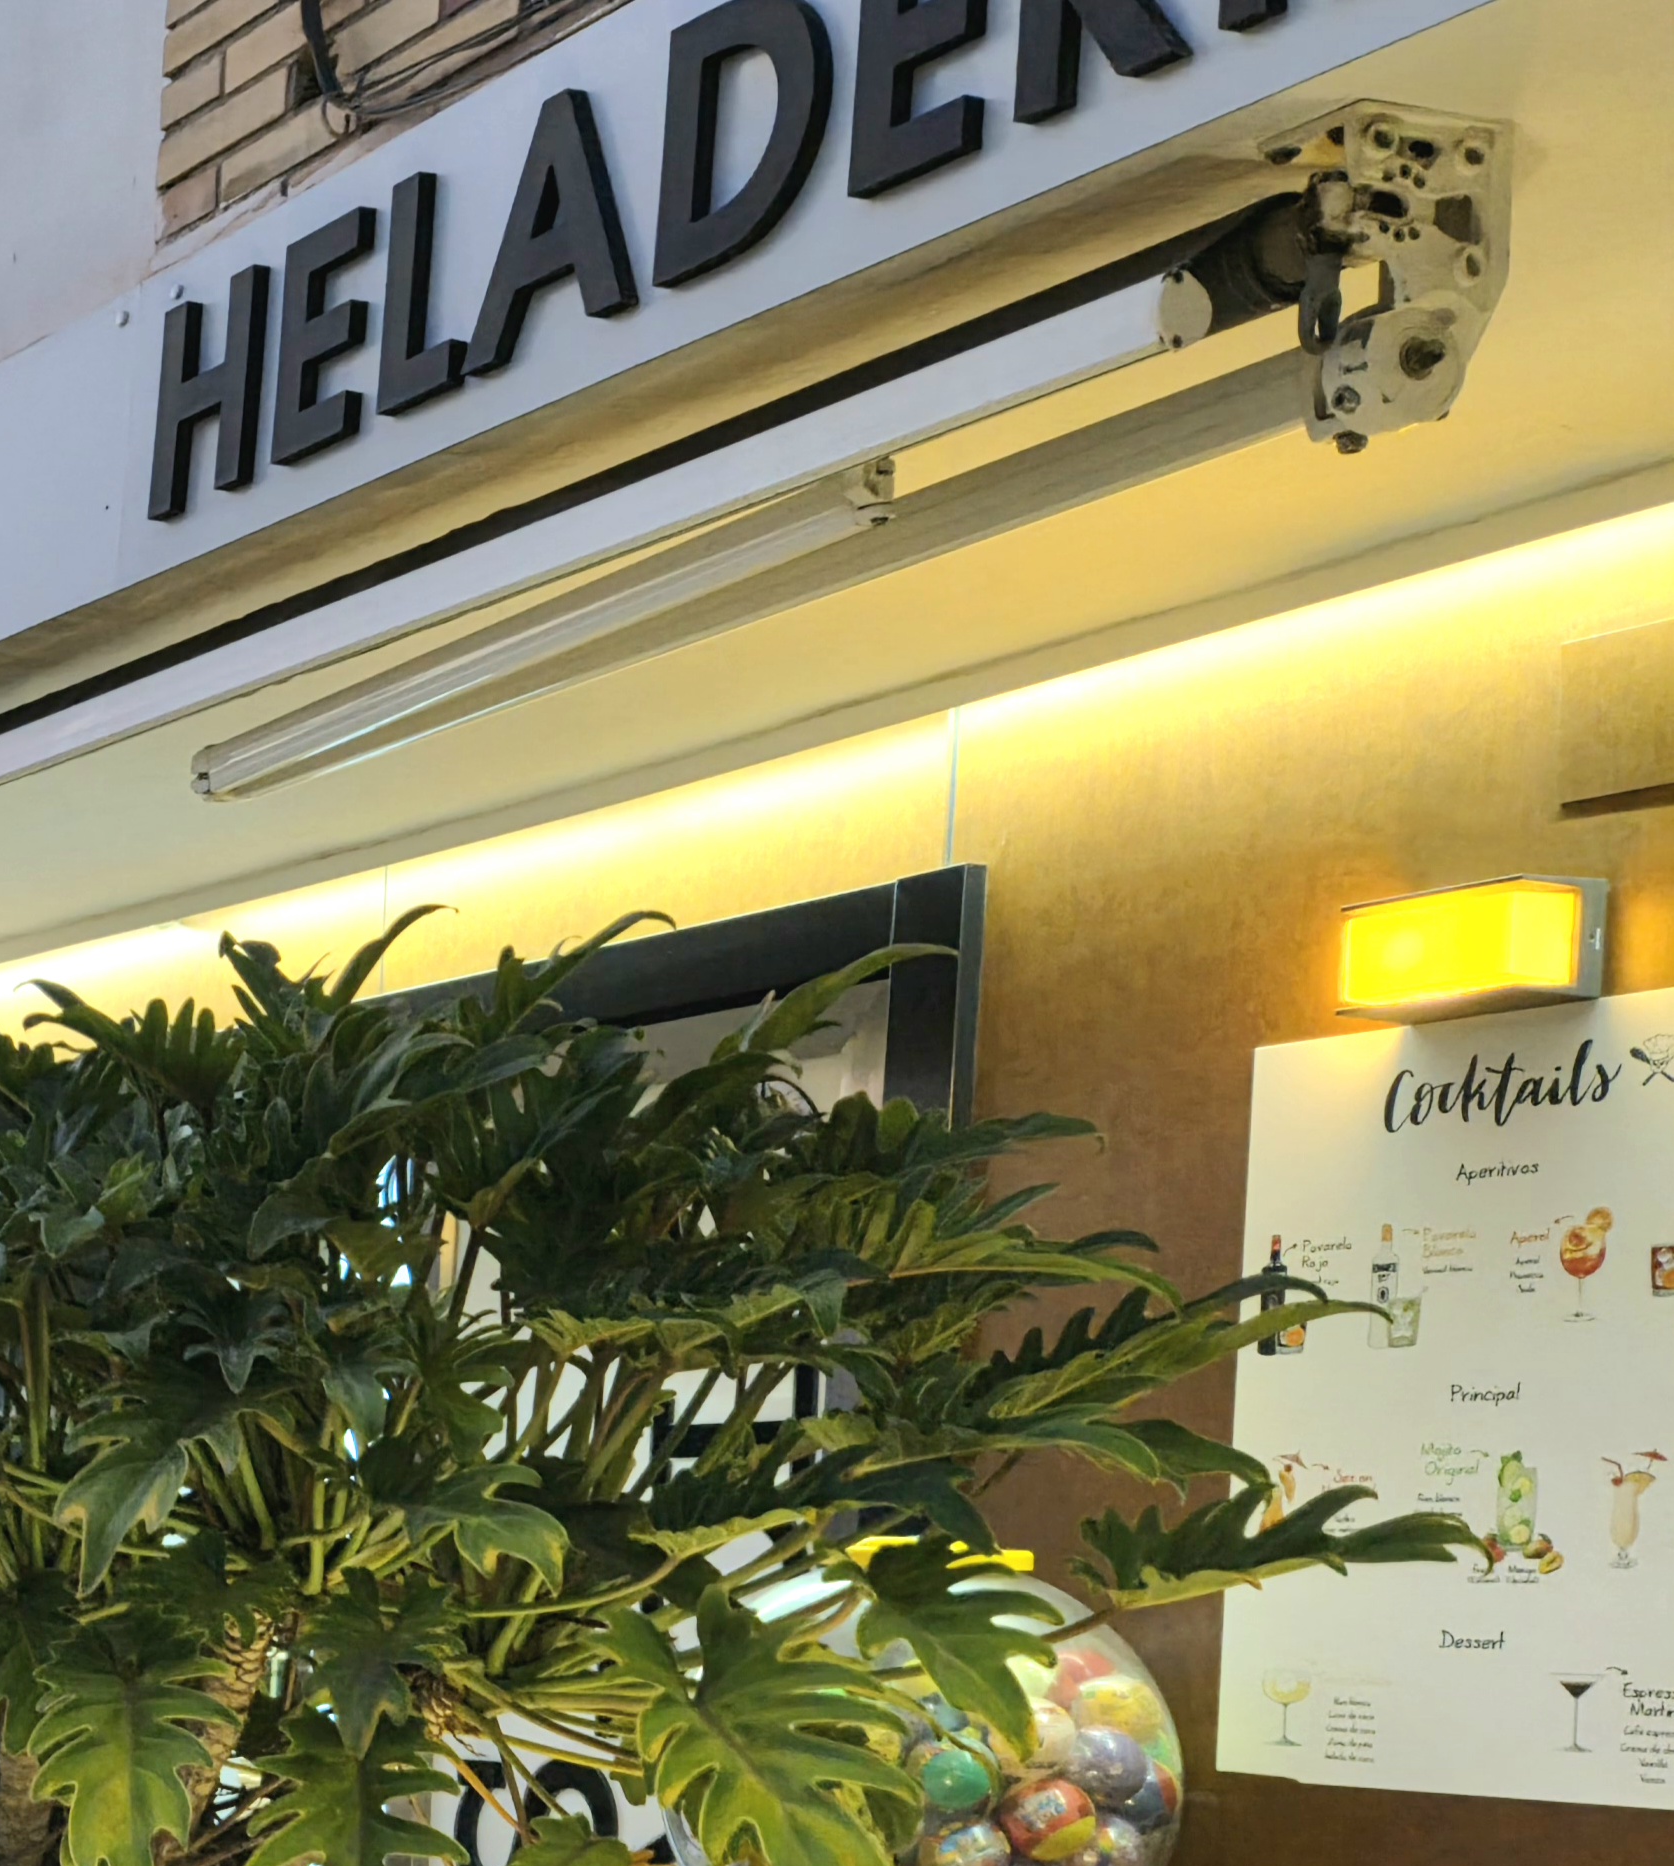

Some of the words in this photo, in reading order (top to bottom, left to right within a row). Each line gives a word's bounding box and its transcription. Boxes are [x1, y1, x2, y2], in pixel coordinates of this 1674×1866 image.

[1384, 1039, 1622, 1133] Cocktails
[1455, 1161, 1539, 1185] Aperitivos
[1302, 1256, 1329, 1272] Rojo
[1450, 1382, 1521, 1407] Principal
[1424, 1459, 1480, 1486] Original
[1439, 1628, 1506, 1651] Dessert
